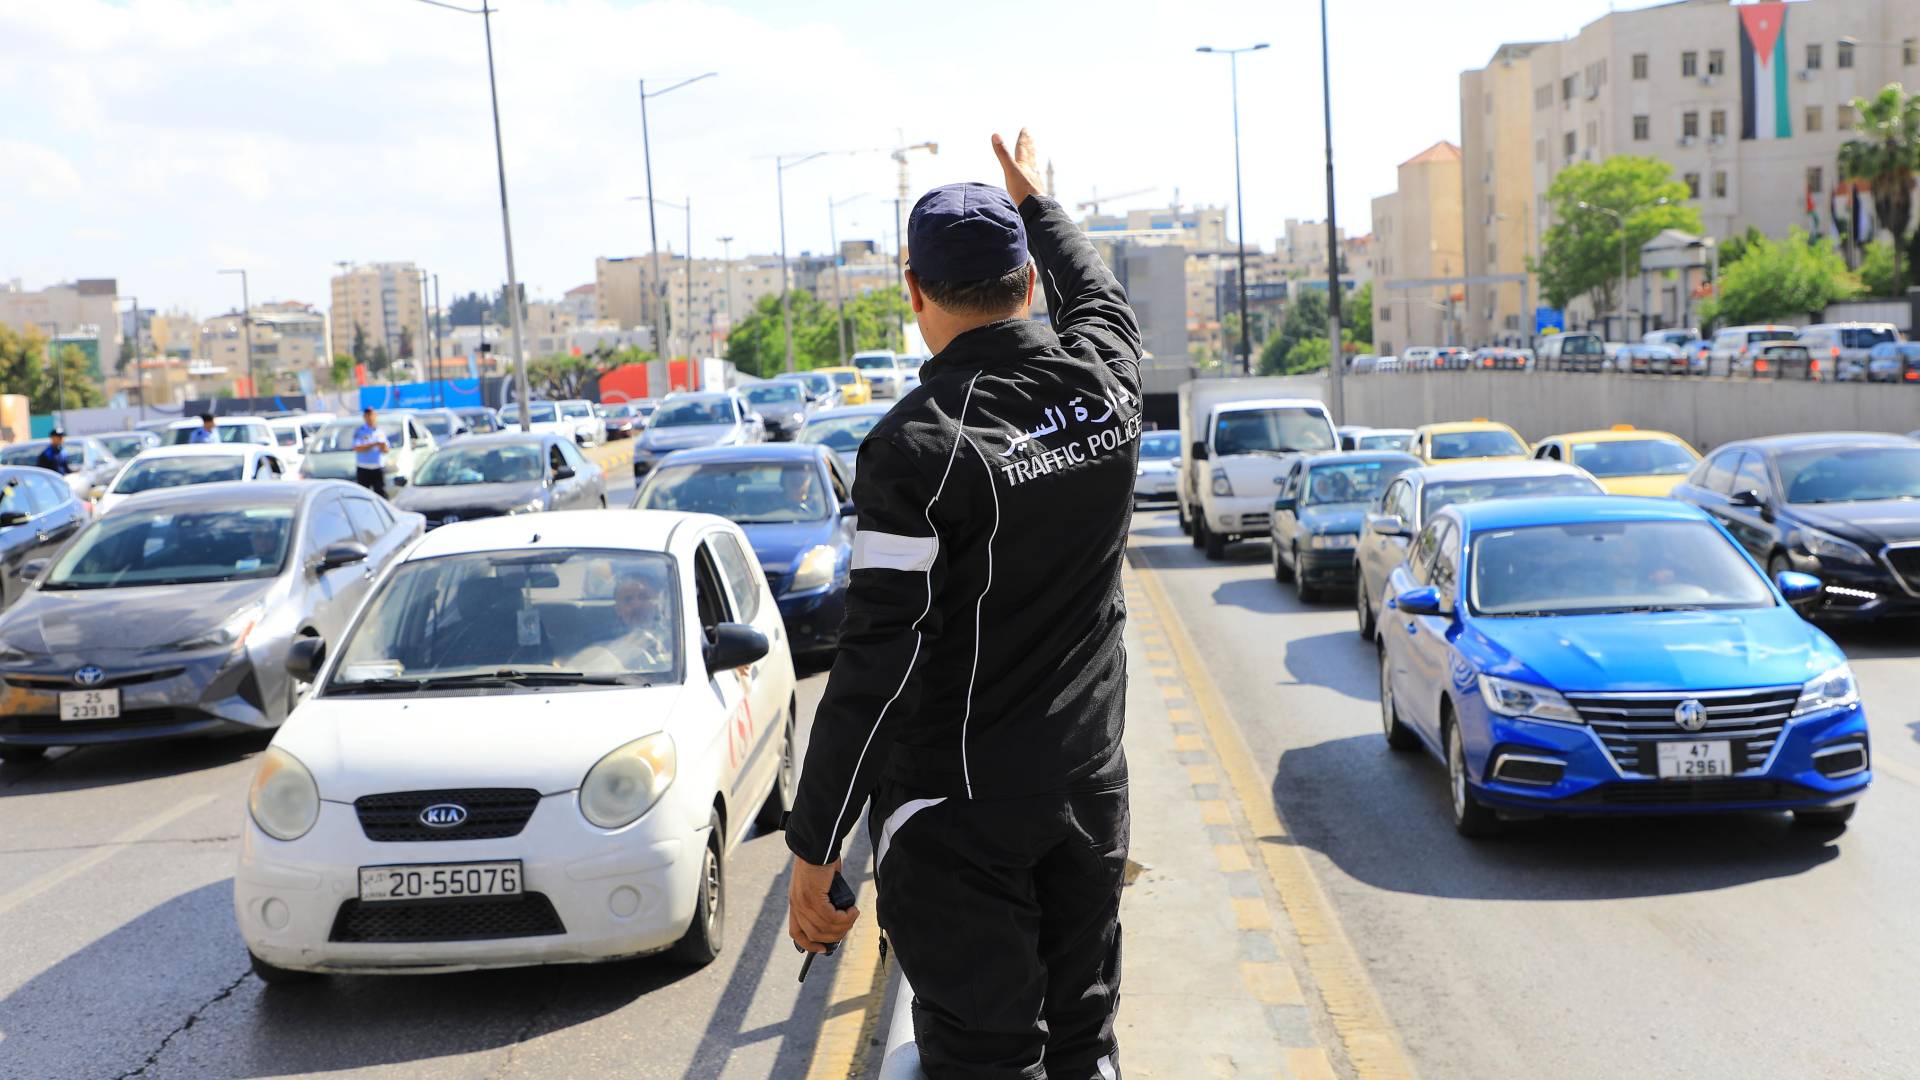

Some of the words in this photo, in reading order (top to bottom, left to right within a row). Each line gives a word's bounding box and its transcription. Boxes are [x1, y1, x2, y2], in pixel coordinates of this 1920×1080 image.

[998, 405, 1067, 457] السير
[1001, 442, 1085, 487] TRAFFIC
[1087, 413, 1142, 457] POLICE
[1690, 744, 1709, 757] 47
[427, 808, 459, 823] KIA
[389, 868, 516, 898] 20-55076
